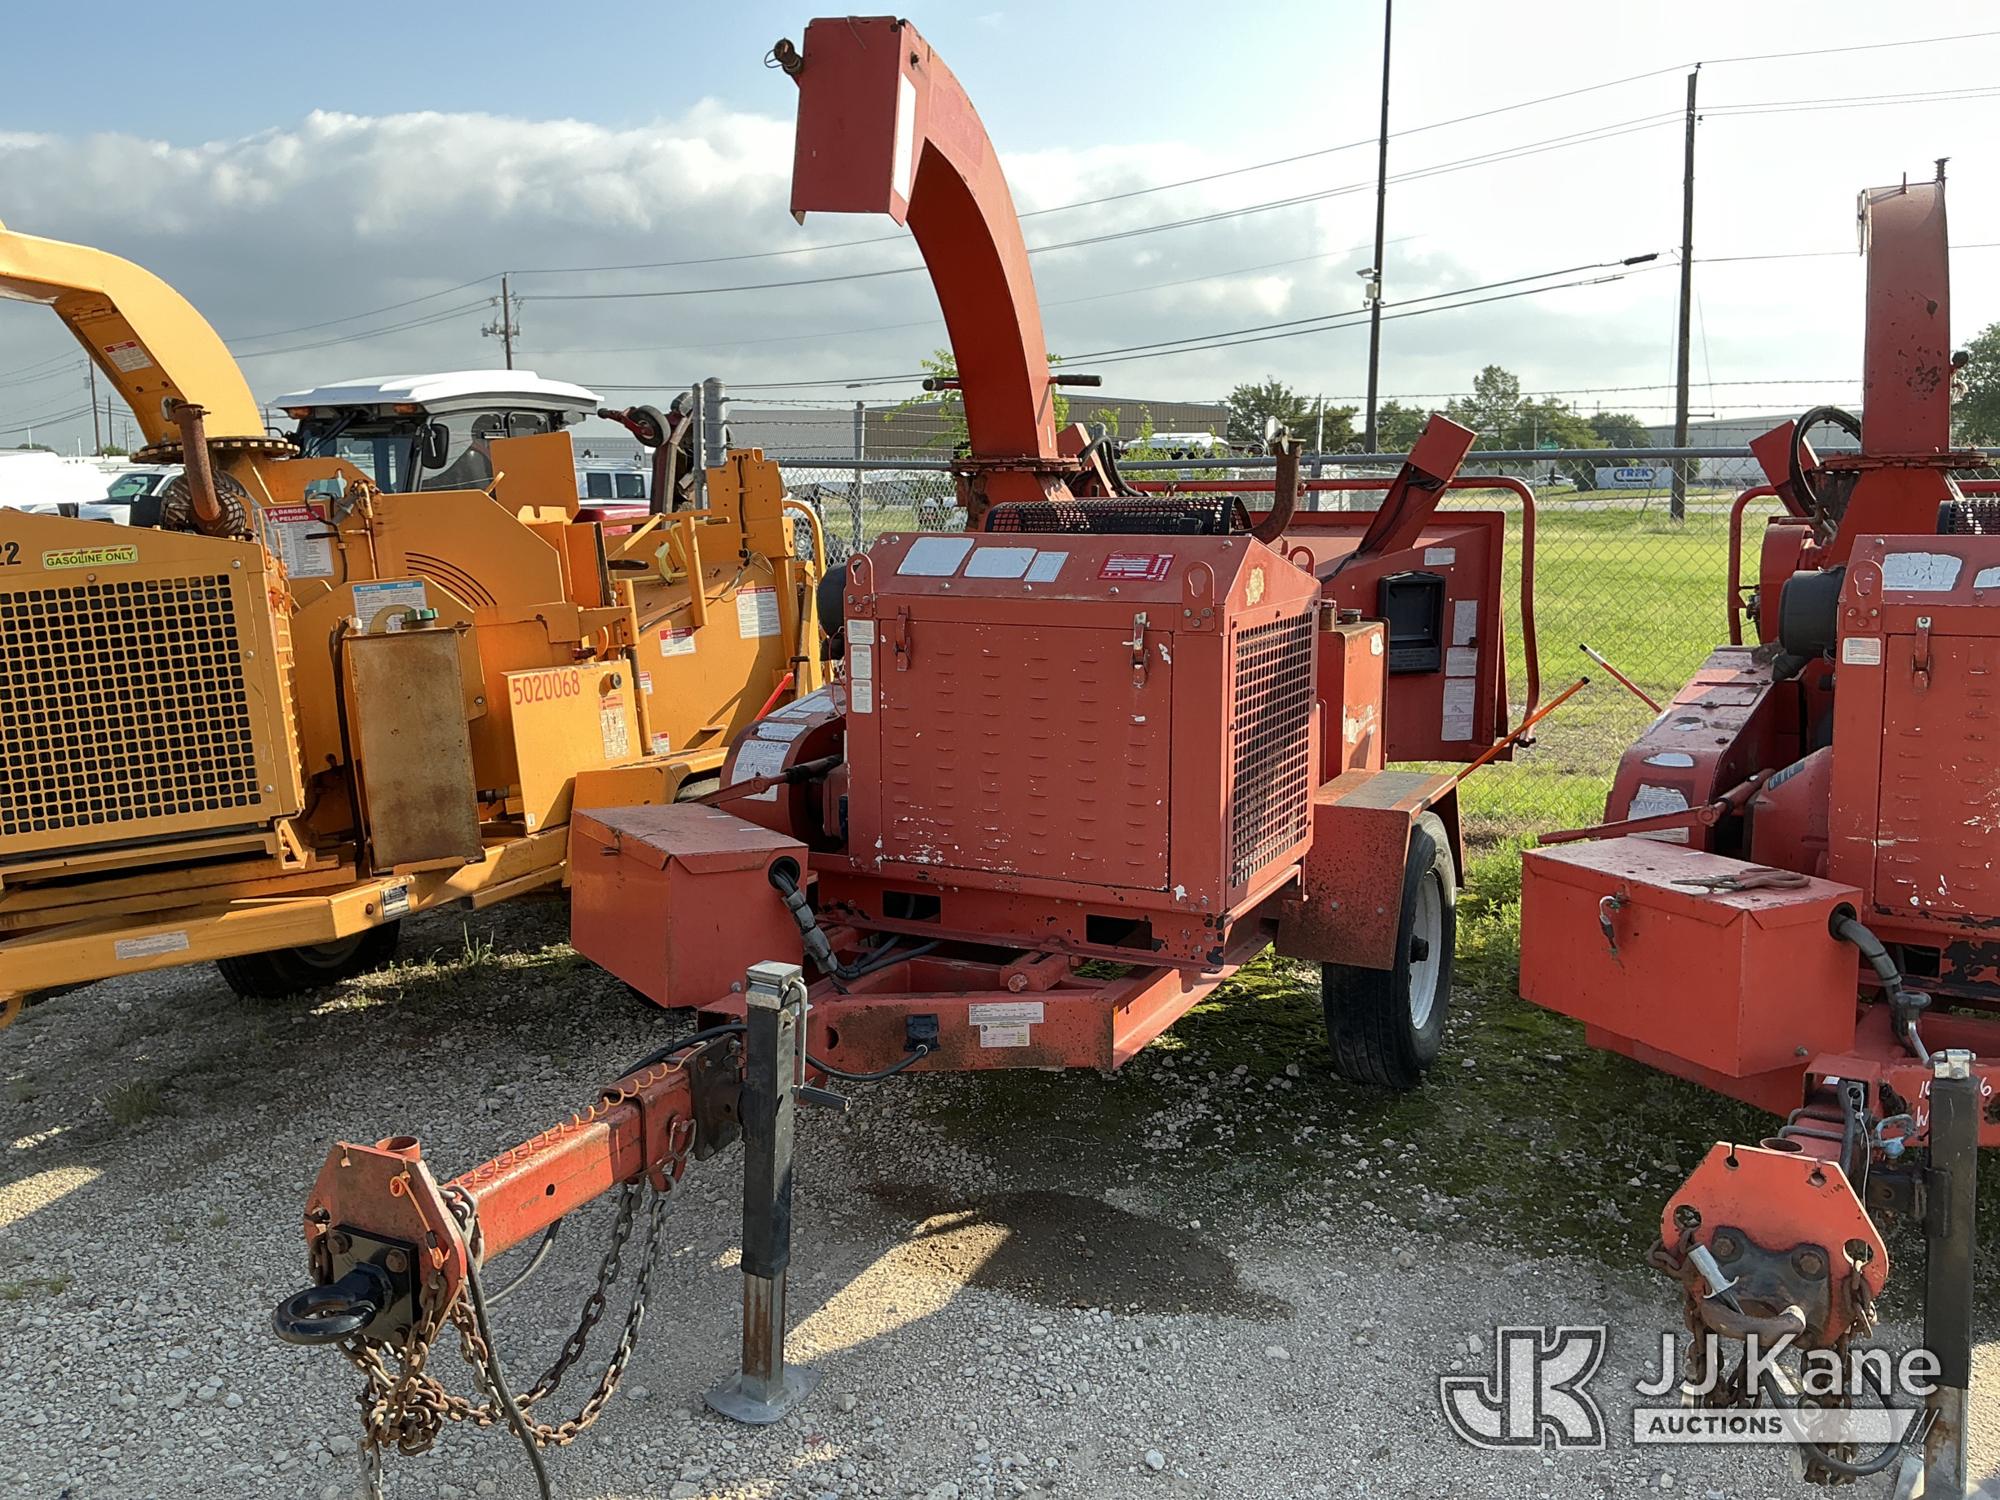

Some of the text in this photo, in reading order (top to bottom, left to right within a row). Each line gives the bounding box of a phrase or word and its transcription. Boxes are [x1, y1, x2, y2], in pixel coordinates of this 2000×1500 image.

[0, 541, 21, 566] 2
[46, 551, 134, 566] GASOLINE ONLY
[512, 670, 581, 705] 5020068
[1637, 801, 1677, 811] AVISO
